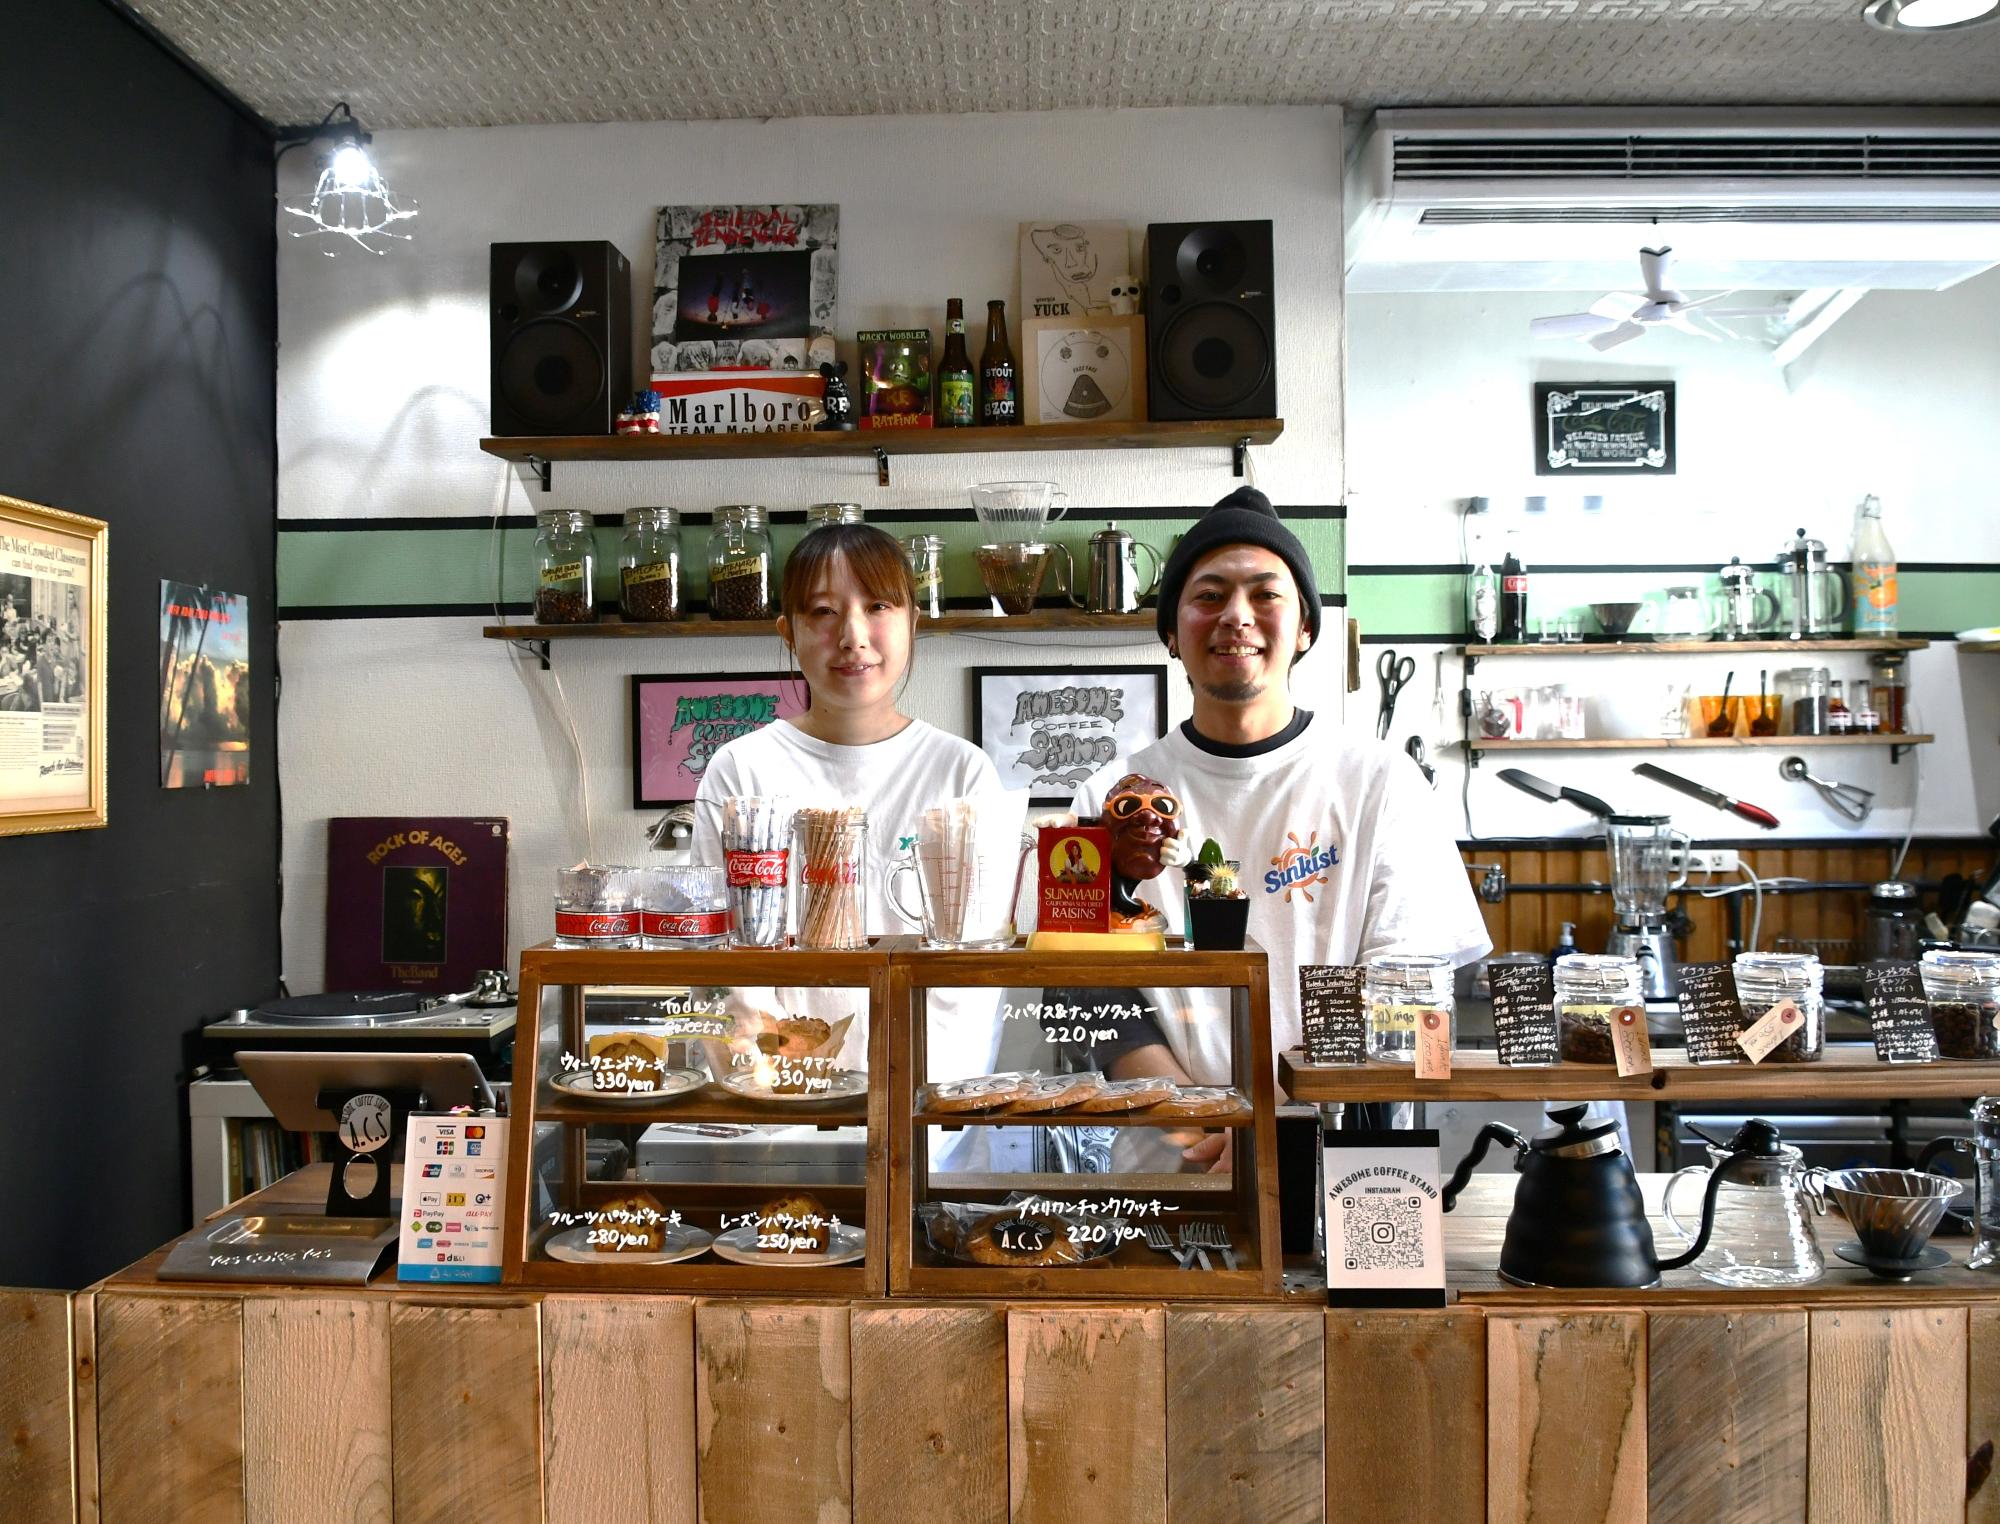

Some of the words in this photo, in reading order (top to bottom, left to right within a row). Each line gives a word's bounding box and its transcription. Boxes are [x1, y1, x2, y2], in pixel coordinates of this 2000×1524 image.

[1033, 303, 1070, 317] YUCK
[858, 331, 888, 341] WACKY
[889, 330, 927, 340] WOBBLER
[985, 367, 1013, 378] STOUT
[669, 393, 811, 424] Marlboro
[984, 400, 1015, 417] SZOT
[669, 426, 715, 435] TEAM
[727, 423, 812, 434] McLAREN
[1581, 450, 1599, 458] THE
[1601, 449, 1643, 458] WORLD
[11, 537, 27, 555] Most
[28, 541, 55, 561] Crowded
[1011, 686, 1125, 727] AWESOME
[1031, 719, 1104, 731] COFFEE
[1016, 730, 1118, 772] STAND
[366, 833, 407, 865] ROCK
[408, 830, 430, 845] OF
[429, 836, 468, 866] AGES
[1264, 844, 1340, 894] Sunkist
[1051, 907, 1096, 920] RAISINS
[1328, 1167, 1372, 1200] AWESOME
[1373, 1166, 1410, 1181] COFFEE
[1409, 1174, 1438, 1200] STAND
